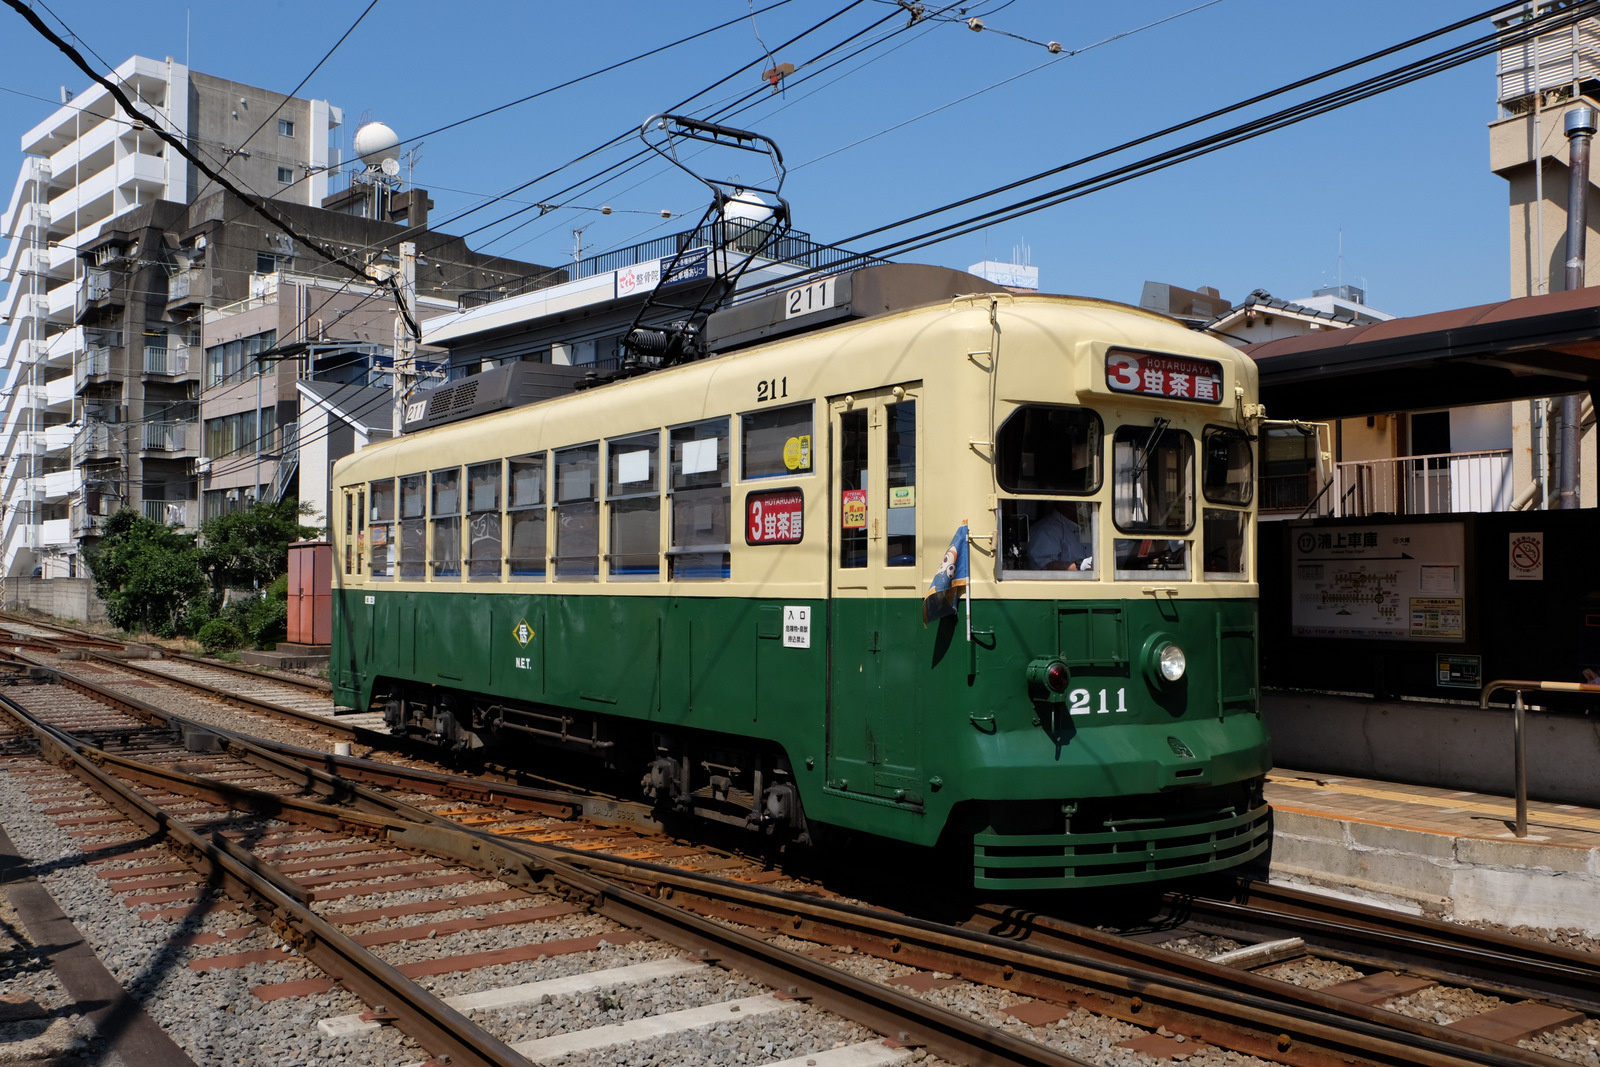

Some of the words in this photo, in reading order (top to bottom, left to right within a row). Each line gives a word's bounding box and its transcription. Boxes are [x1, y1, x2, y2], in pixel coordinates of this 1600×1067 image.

[789, 281, 827, 314] 211
[1108, 354, 1141, 391] 3
[1147, 358, 1210, 375] HOTARUJAYA
[757, 376, 788, 402] 211
[407, 403, 424, 421] 211
[751, 500, 763, 540] 3
[1318, 531, 1378, 549] 浦上車庫
[787, 610, 806, 620] 入口
[1069, 687, 1128, 715] 211
